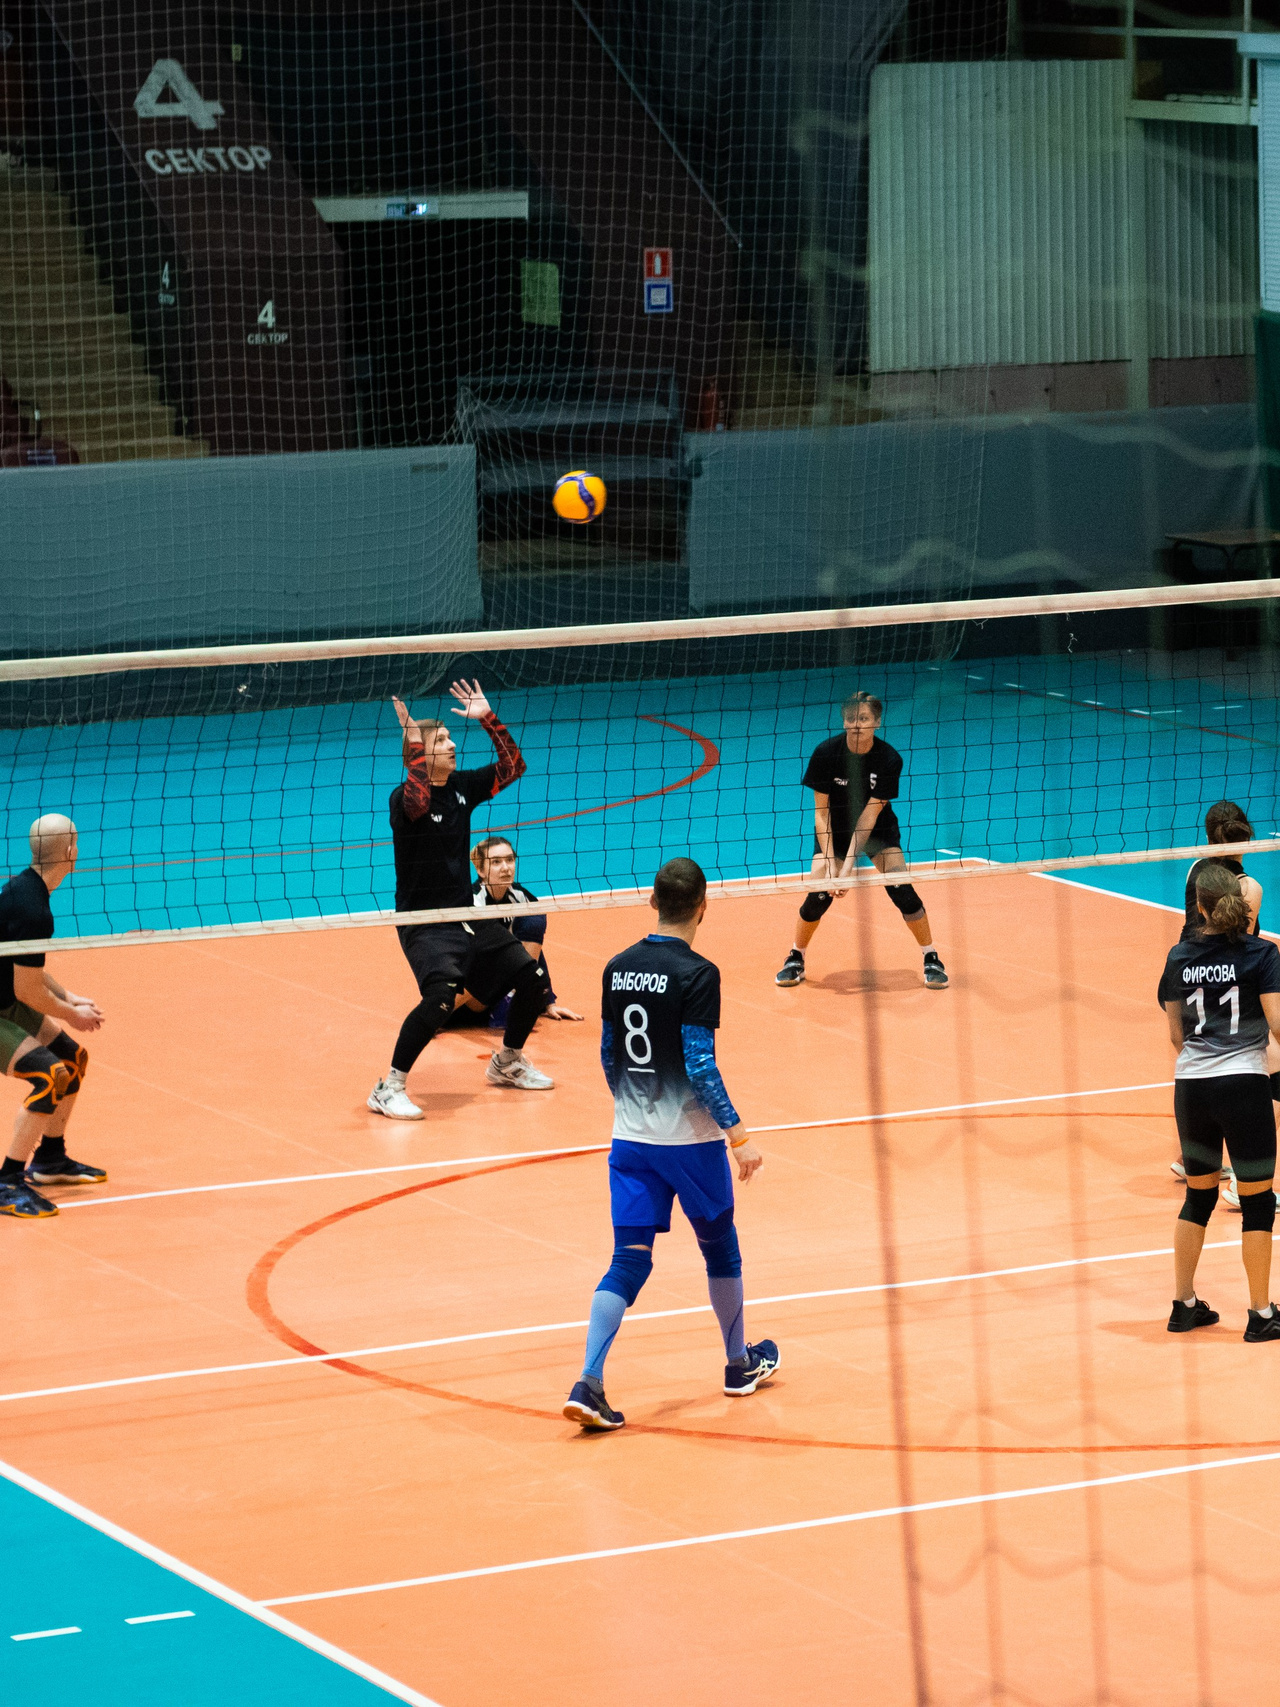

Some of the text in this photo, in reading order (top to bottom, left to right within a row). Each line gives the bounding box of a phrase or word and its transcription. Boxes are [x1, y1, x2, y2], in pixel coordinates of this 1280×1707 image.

[133, 58, 226, 130] 4
[145, 146, 272, 175] СЕКТОР
[162, 261, 170, 289] 4
[257, 300, 276, 328] 4
[611, 971, 668, 993] ВЫБОРОВ
[1182, 964, 1236, 984] ФИРСОВА
[1186, 986, 1239, 1035] 11
[623, 1003, 652, 1065] 8
